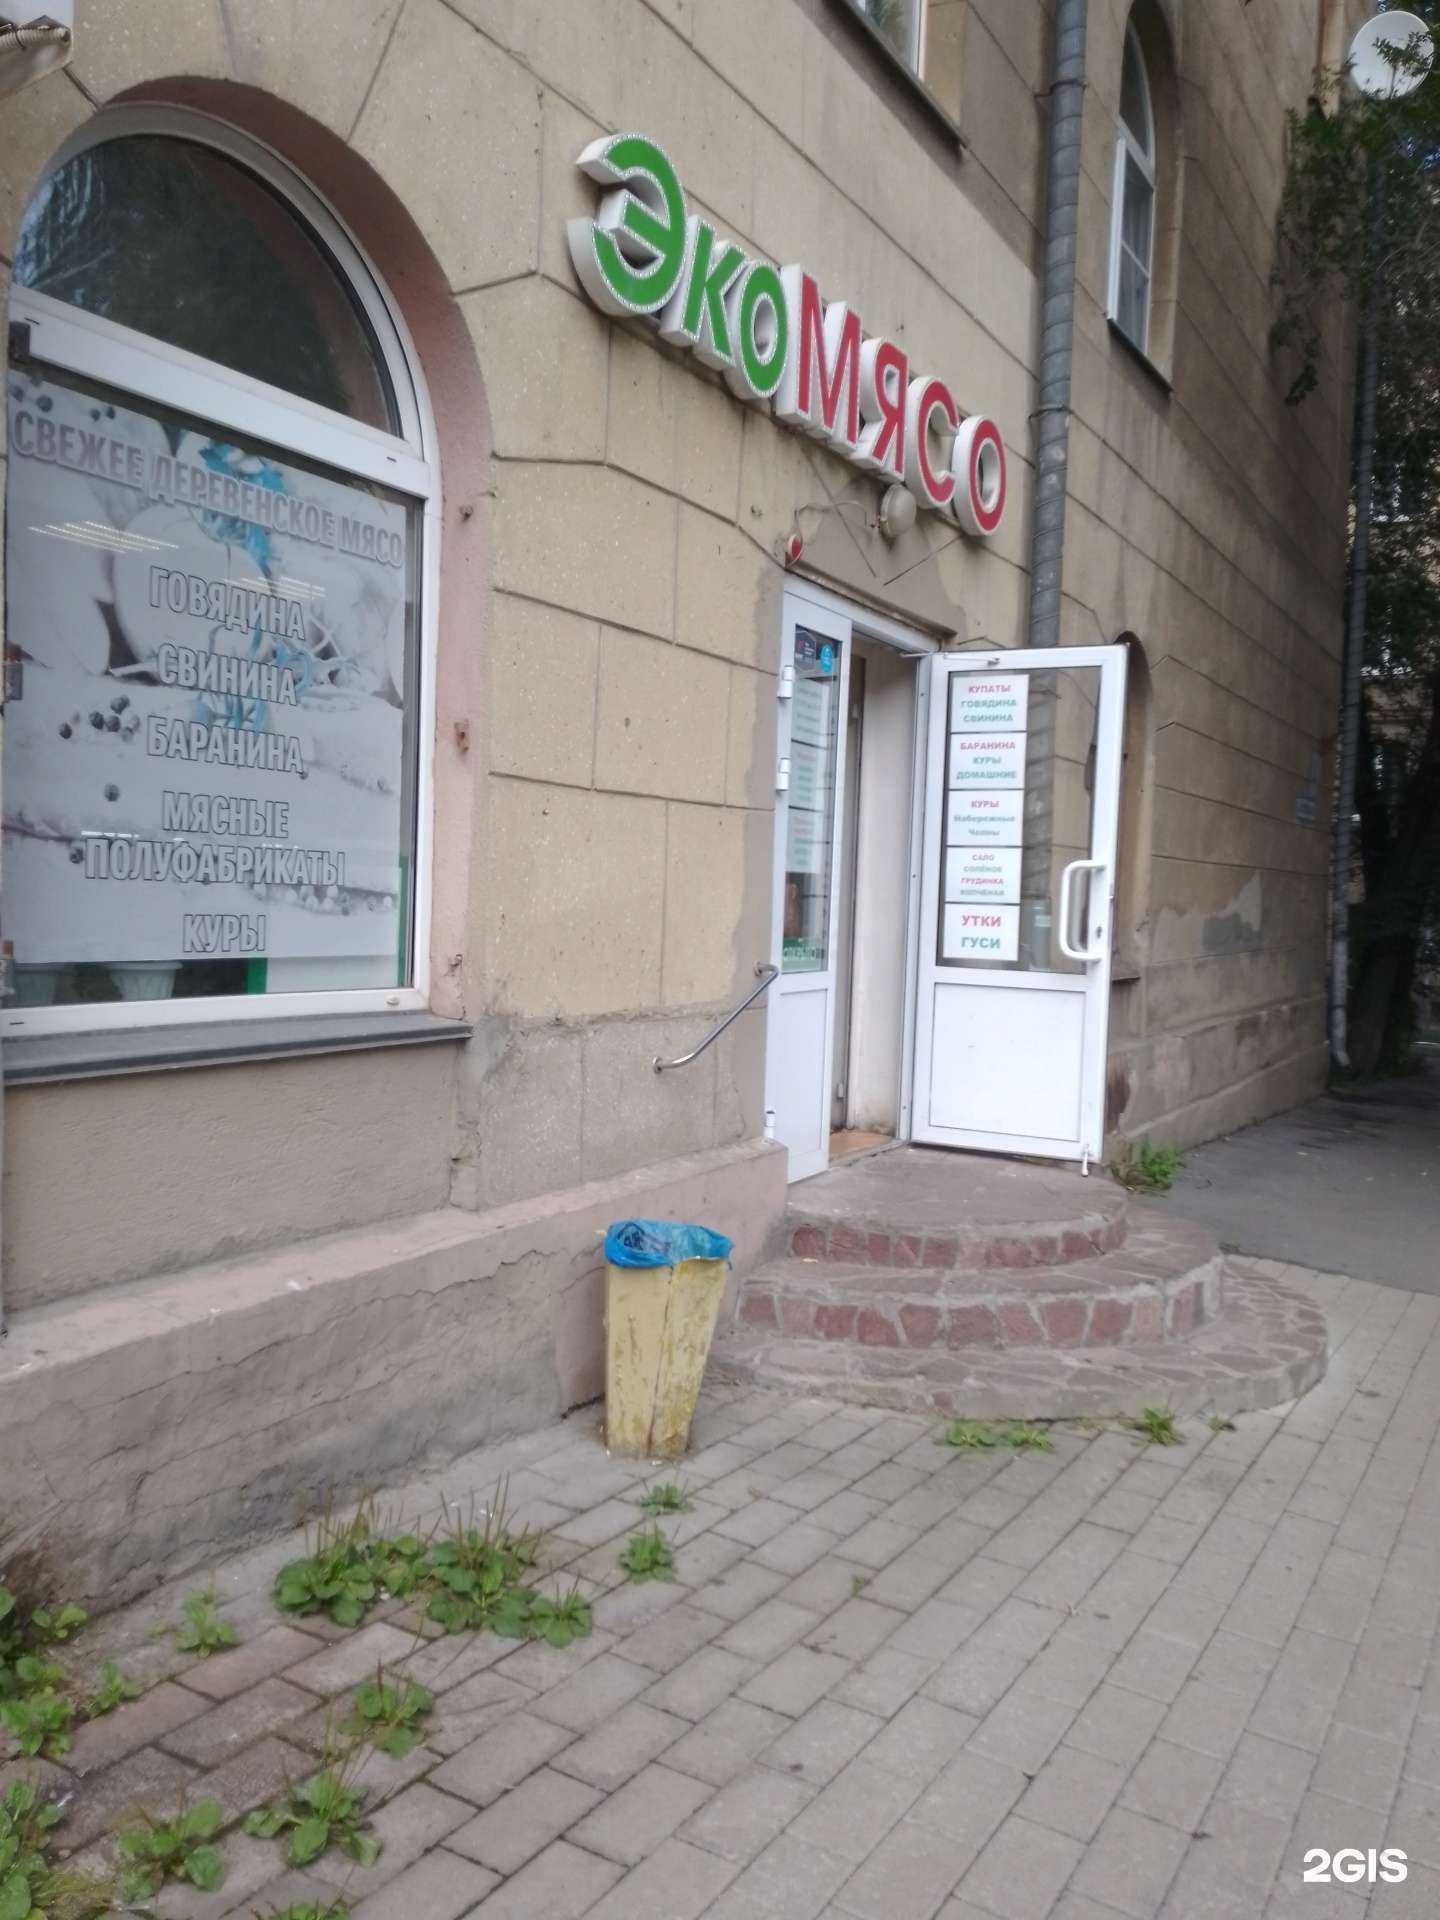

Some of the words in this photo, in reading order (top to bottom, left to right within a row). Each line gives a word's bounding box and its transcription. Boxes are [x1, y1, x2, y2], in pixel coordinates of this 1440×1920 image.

[12, 409, 146, 490] СВЕЖЕЕ
[149, 452, 337, 549] ДЕРЕВЕНСКОЕ
[338, 513, 404, 568] МЯСО
[150, 565, 306, 641] ГОВЯДИНА
[158, 642, 299, 707] СВИНИНА
[968, 684, 1012, 694] КУПАТЫ
[960, 699, 1017, 709] ГОВЯДИНА
[962, 714, 1014, 723] СВИНИНА
[147, 714, 305, 774] БАРАНИНА
[960, 741, 1016, 751] БАРАНИНА
[973, 756, 1002, 765] КУРЫ
[956, 770, 1017, 780] ДОМАШНИЕ
[970, 800, 1000, 808] КУРЫ
[162, 790, 290, 839] МЯСНЫЕ
[84, 836, 346, 887] ПОЛУФАБРИКАТЫ
[961, 915, 1002, 928] УТКИ
[182, 914, 267, 953] КУРЫ
[960, 936, 1001, 949] ГУСИ
